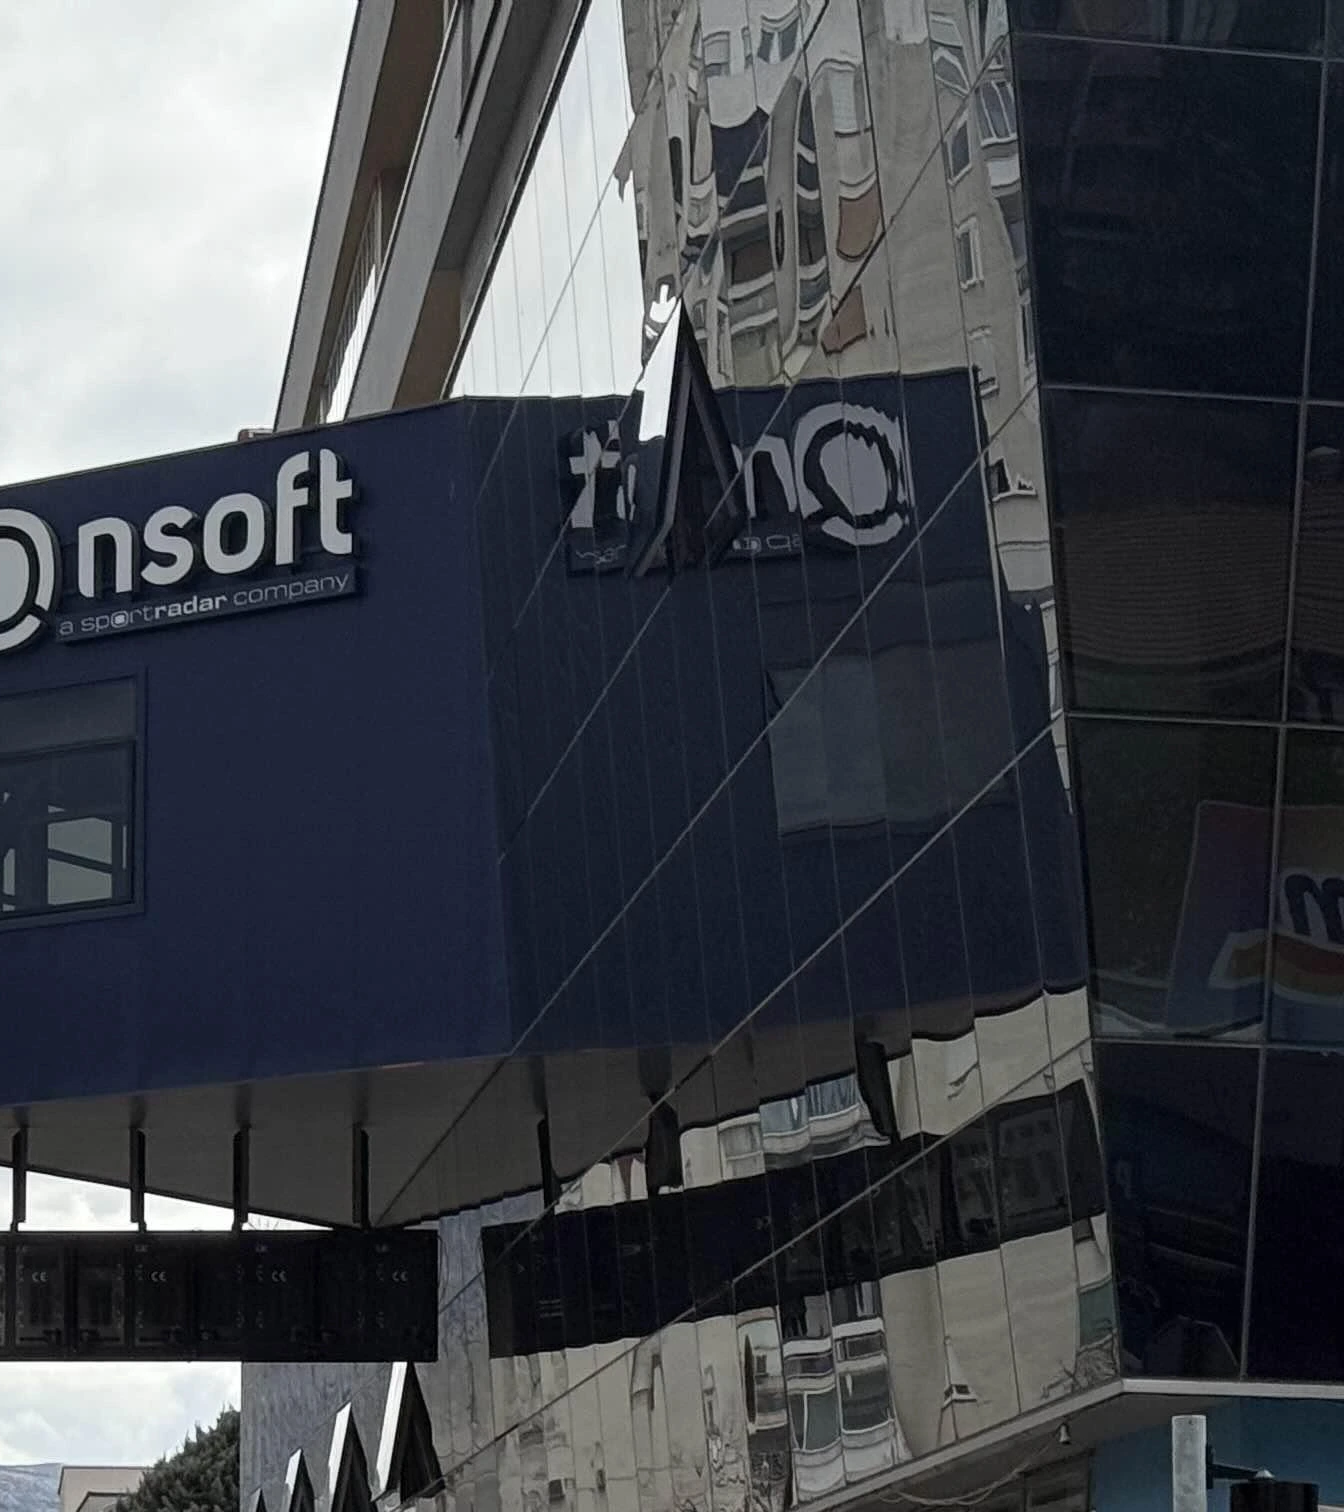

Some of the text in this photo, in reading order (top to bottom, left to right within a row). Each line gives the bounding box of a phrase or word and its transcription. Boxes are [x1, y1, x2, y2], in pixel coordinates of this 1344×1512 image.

[77, 448, 353, 598] nsoft
[60, 574, 350, 635] a sportradar company
